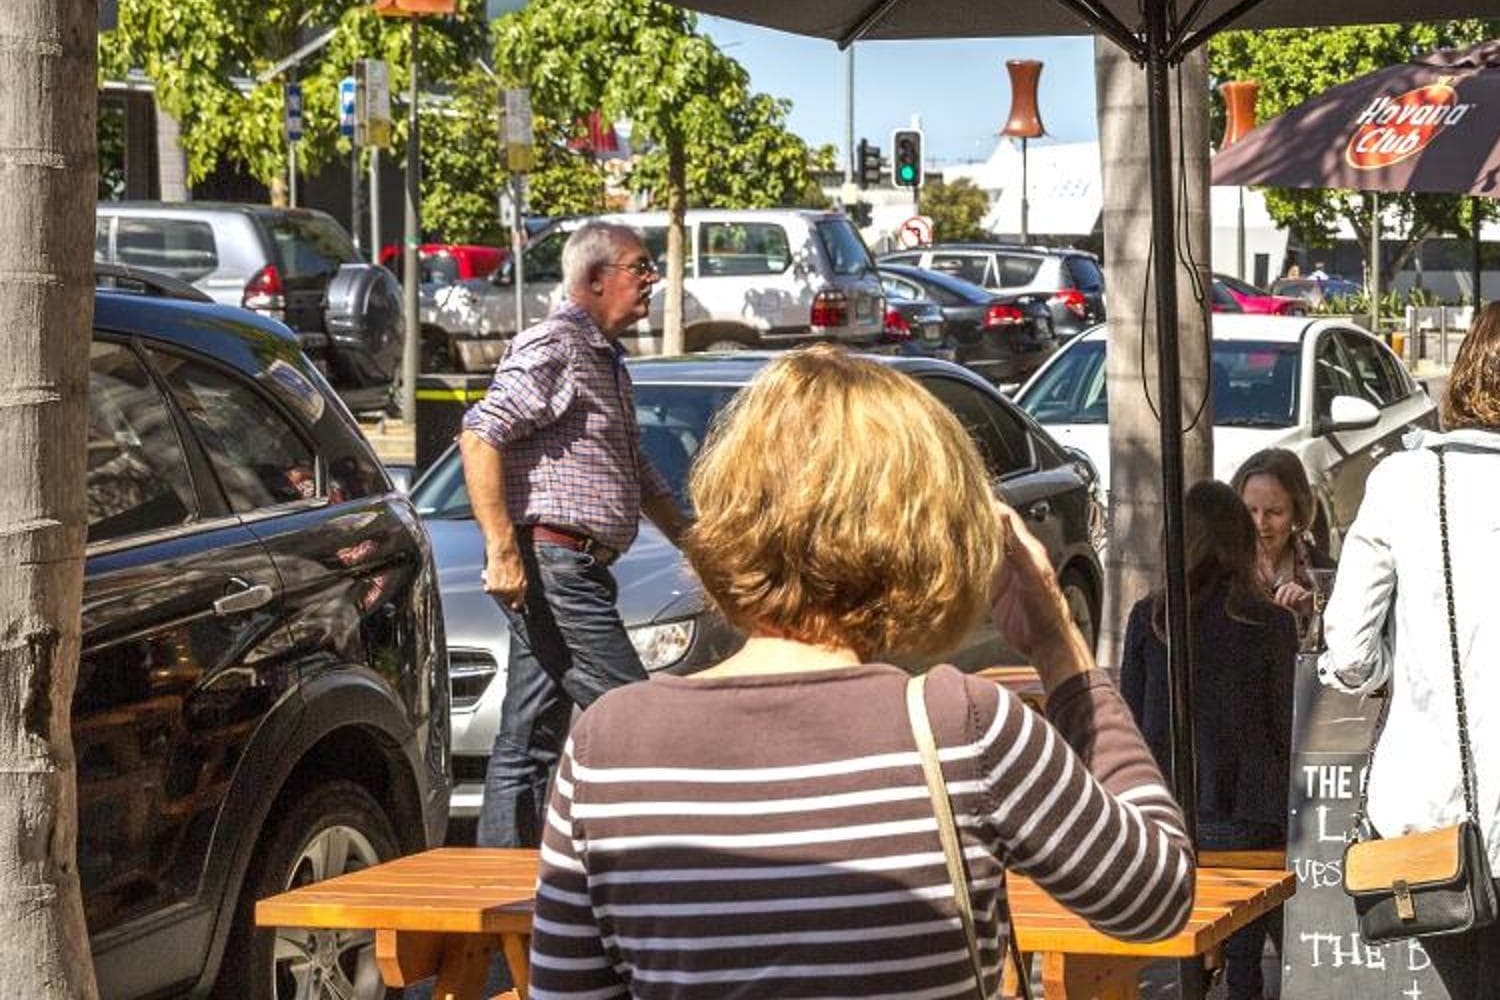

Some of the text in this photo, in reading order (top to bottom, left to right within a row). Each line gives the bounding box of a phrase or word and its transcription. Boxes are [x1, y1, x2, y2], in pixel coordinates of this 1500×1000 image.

[1355, 96, 1470, 125] Havana
[1355, 126, 1421, 153] Club
[1303, 765, 1353, 799] THE
[1300, 931, 1386, 970] THE
